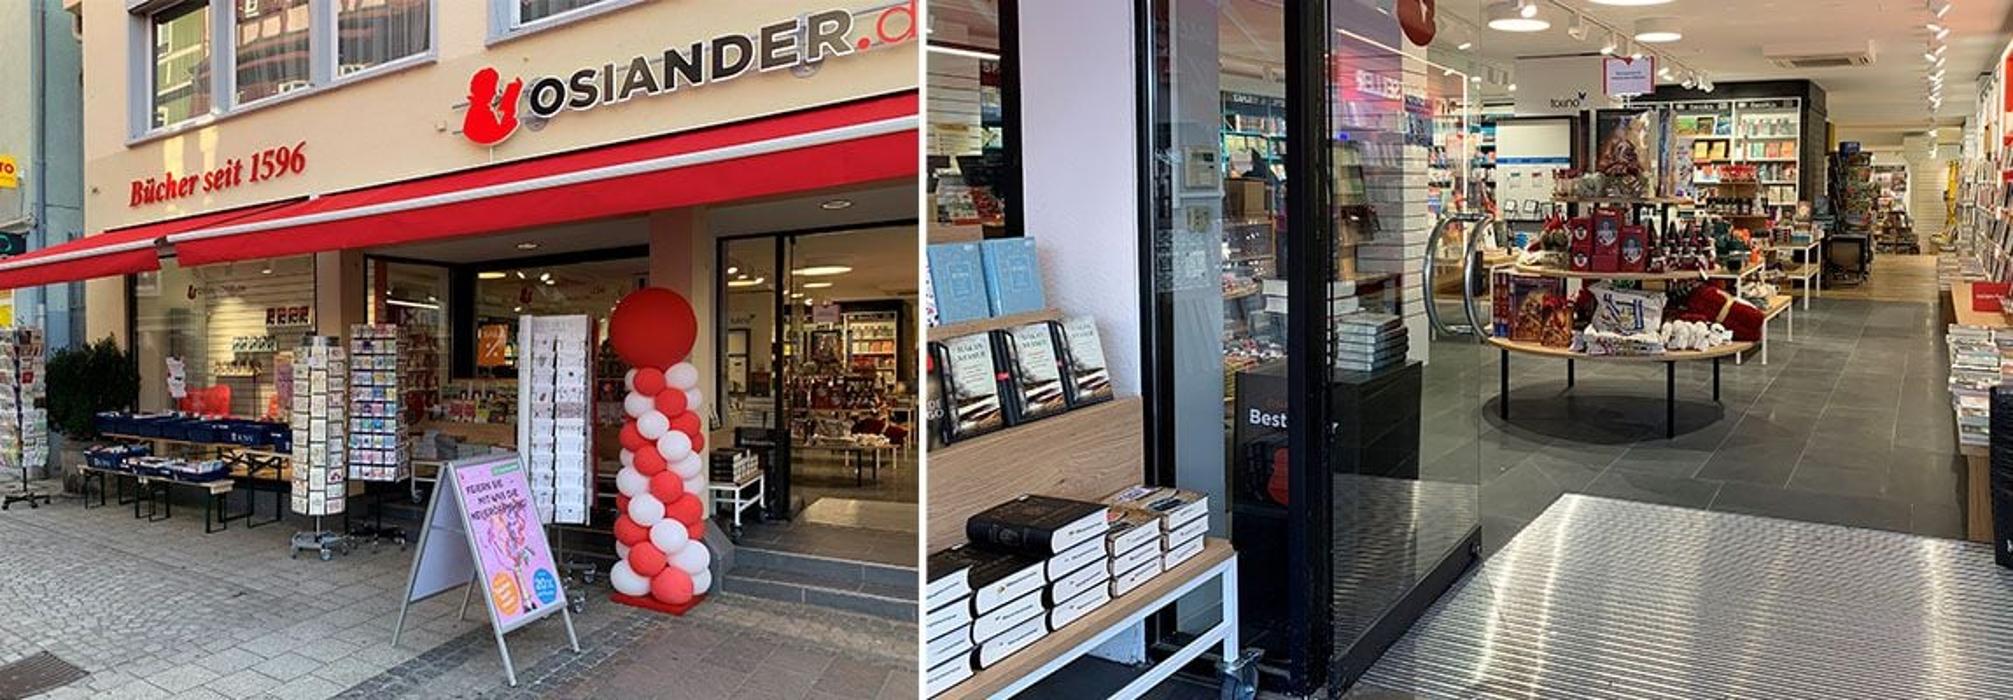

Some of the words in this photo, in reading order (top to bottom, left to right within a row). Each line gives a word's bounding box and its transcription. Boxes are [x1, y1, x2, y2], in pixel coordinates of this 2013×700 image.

[129, 171, 199, 207] Bücher
[202, 158, 243, 192] seit
[249, 140, 307, 183] 1596
